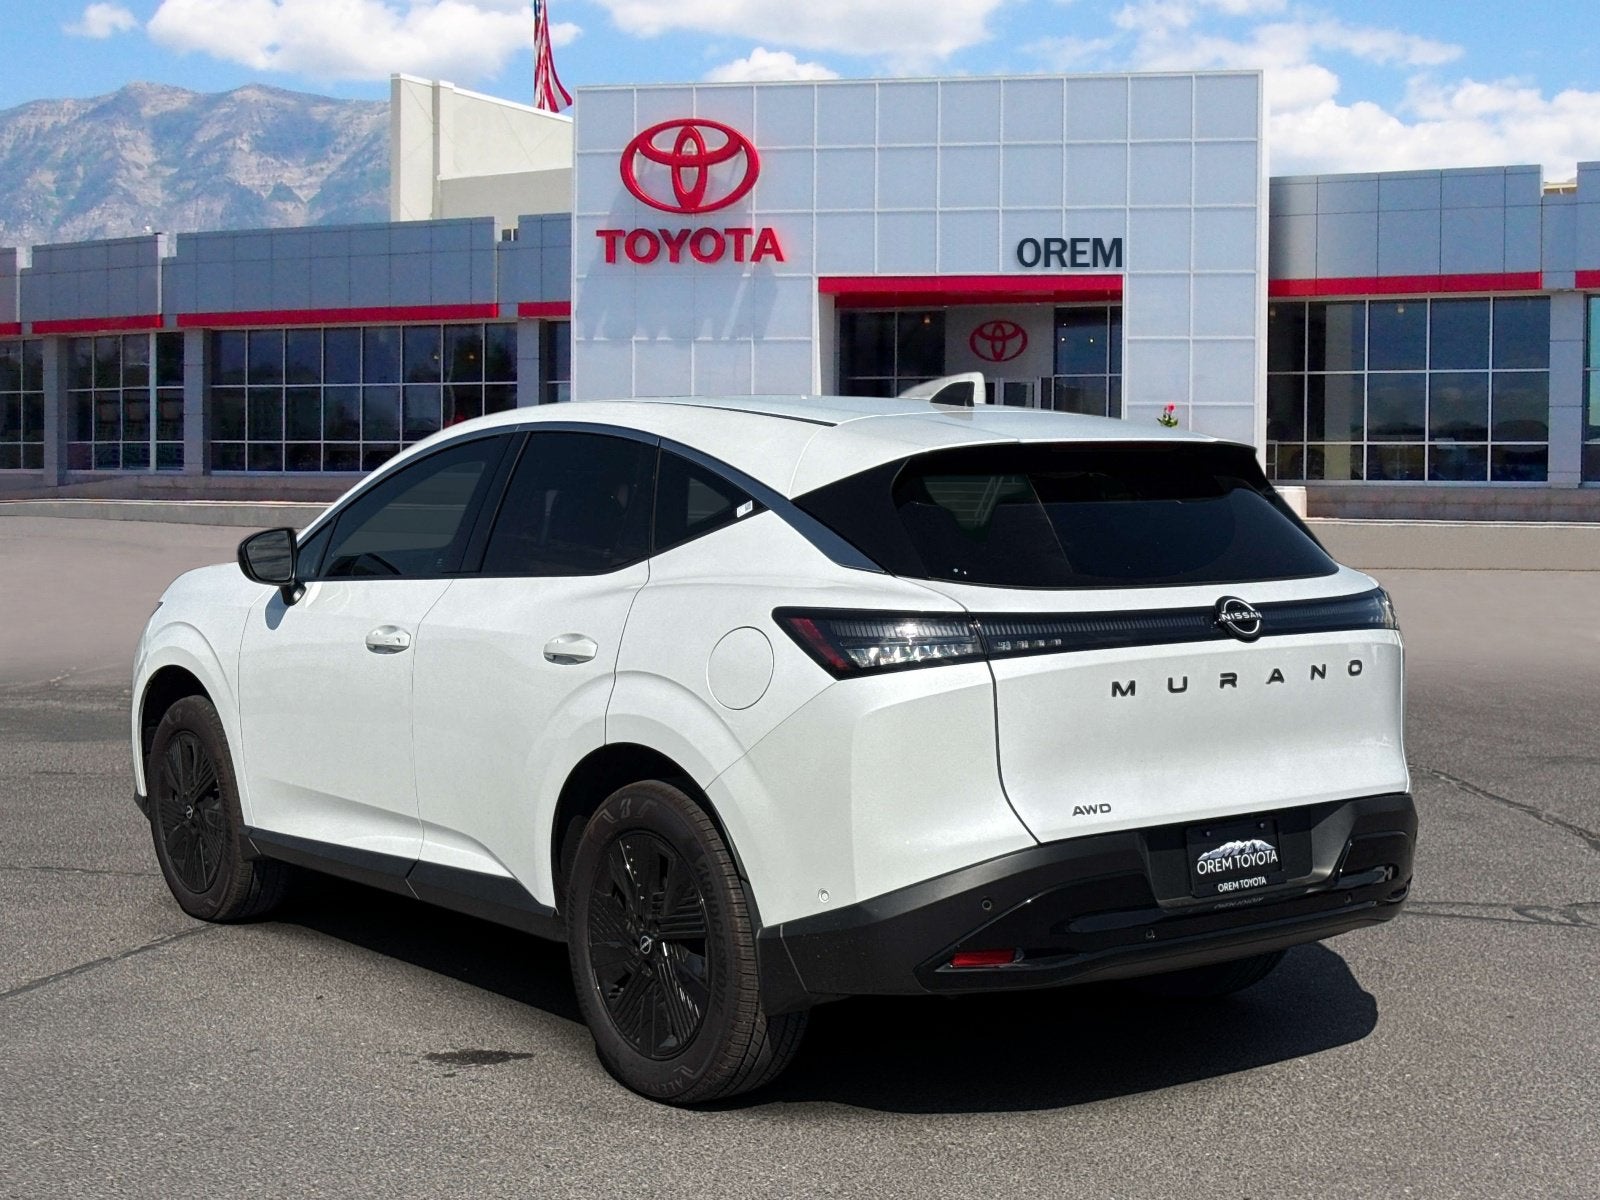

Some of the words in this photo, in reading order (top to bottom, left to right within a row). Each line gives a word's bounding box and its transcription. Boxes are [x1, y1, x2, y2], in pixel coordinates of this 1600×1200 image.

[596, 227, 785, 264] TOYOTA
[1016, 237, 1123, 268] OREM
[1221, 611, 1262, 621] NISSAN
[1111, 659, 1364, 698] MURANO
[1072, 803, 1112, 817] AWD
[1197, 857, 1233, 875] OREM
[1234, 849, 1279, 869] TOYOTA
[1217, 881, 1240, 893] OREM
[1239, 876, 1267, 889] TOYOTA
